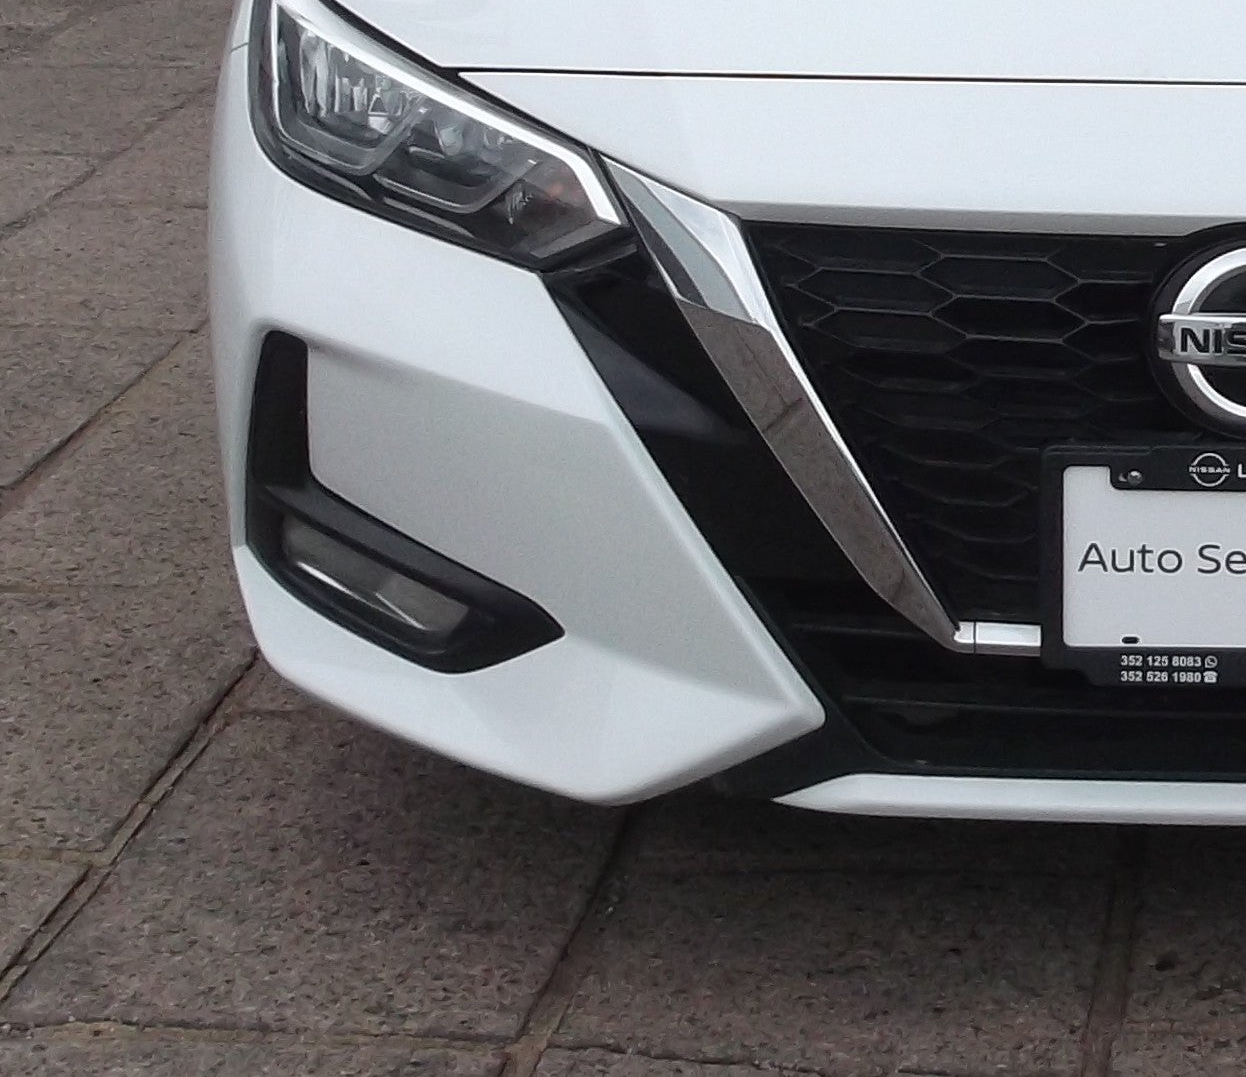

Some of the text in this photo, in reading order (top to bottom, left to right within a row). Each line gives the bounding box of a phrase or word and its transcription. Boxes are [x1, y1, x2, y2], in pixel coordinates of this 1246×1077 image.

[1189, 466, 1231, 474] NISSAN
[1079, 542, 1183, 574] Auto
[1120, 655, 1143, 666] 352
[1120, 671, 1143, 682] 352
